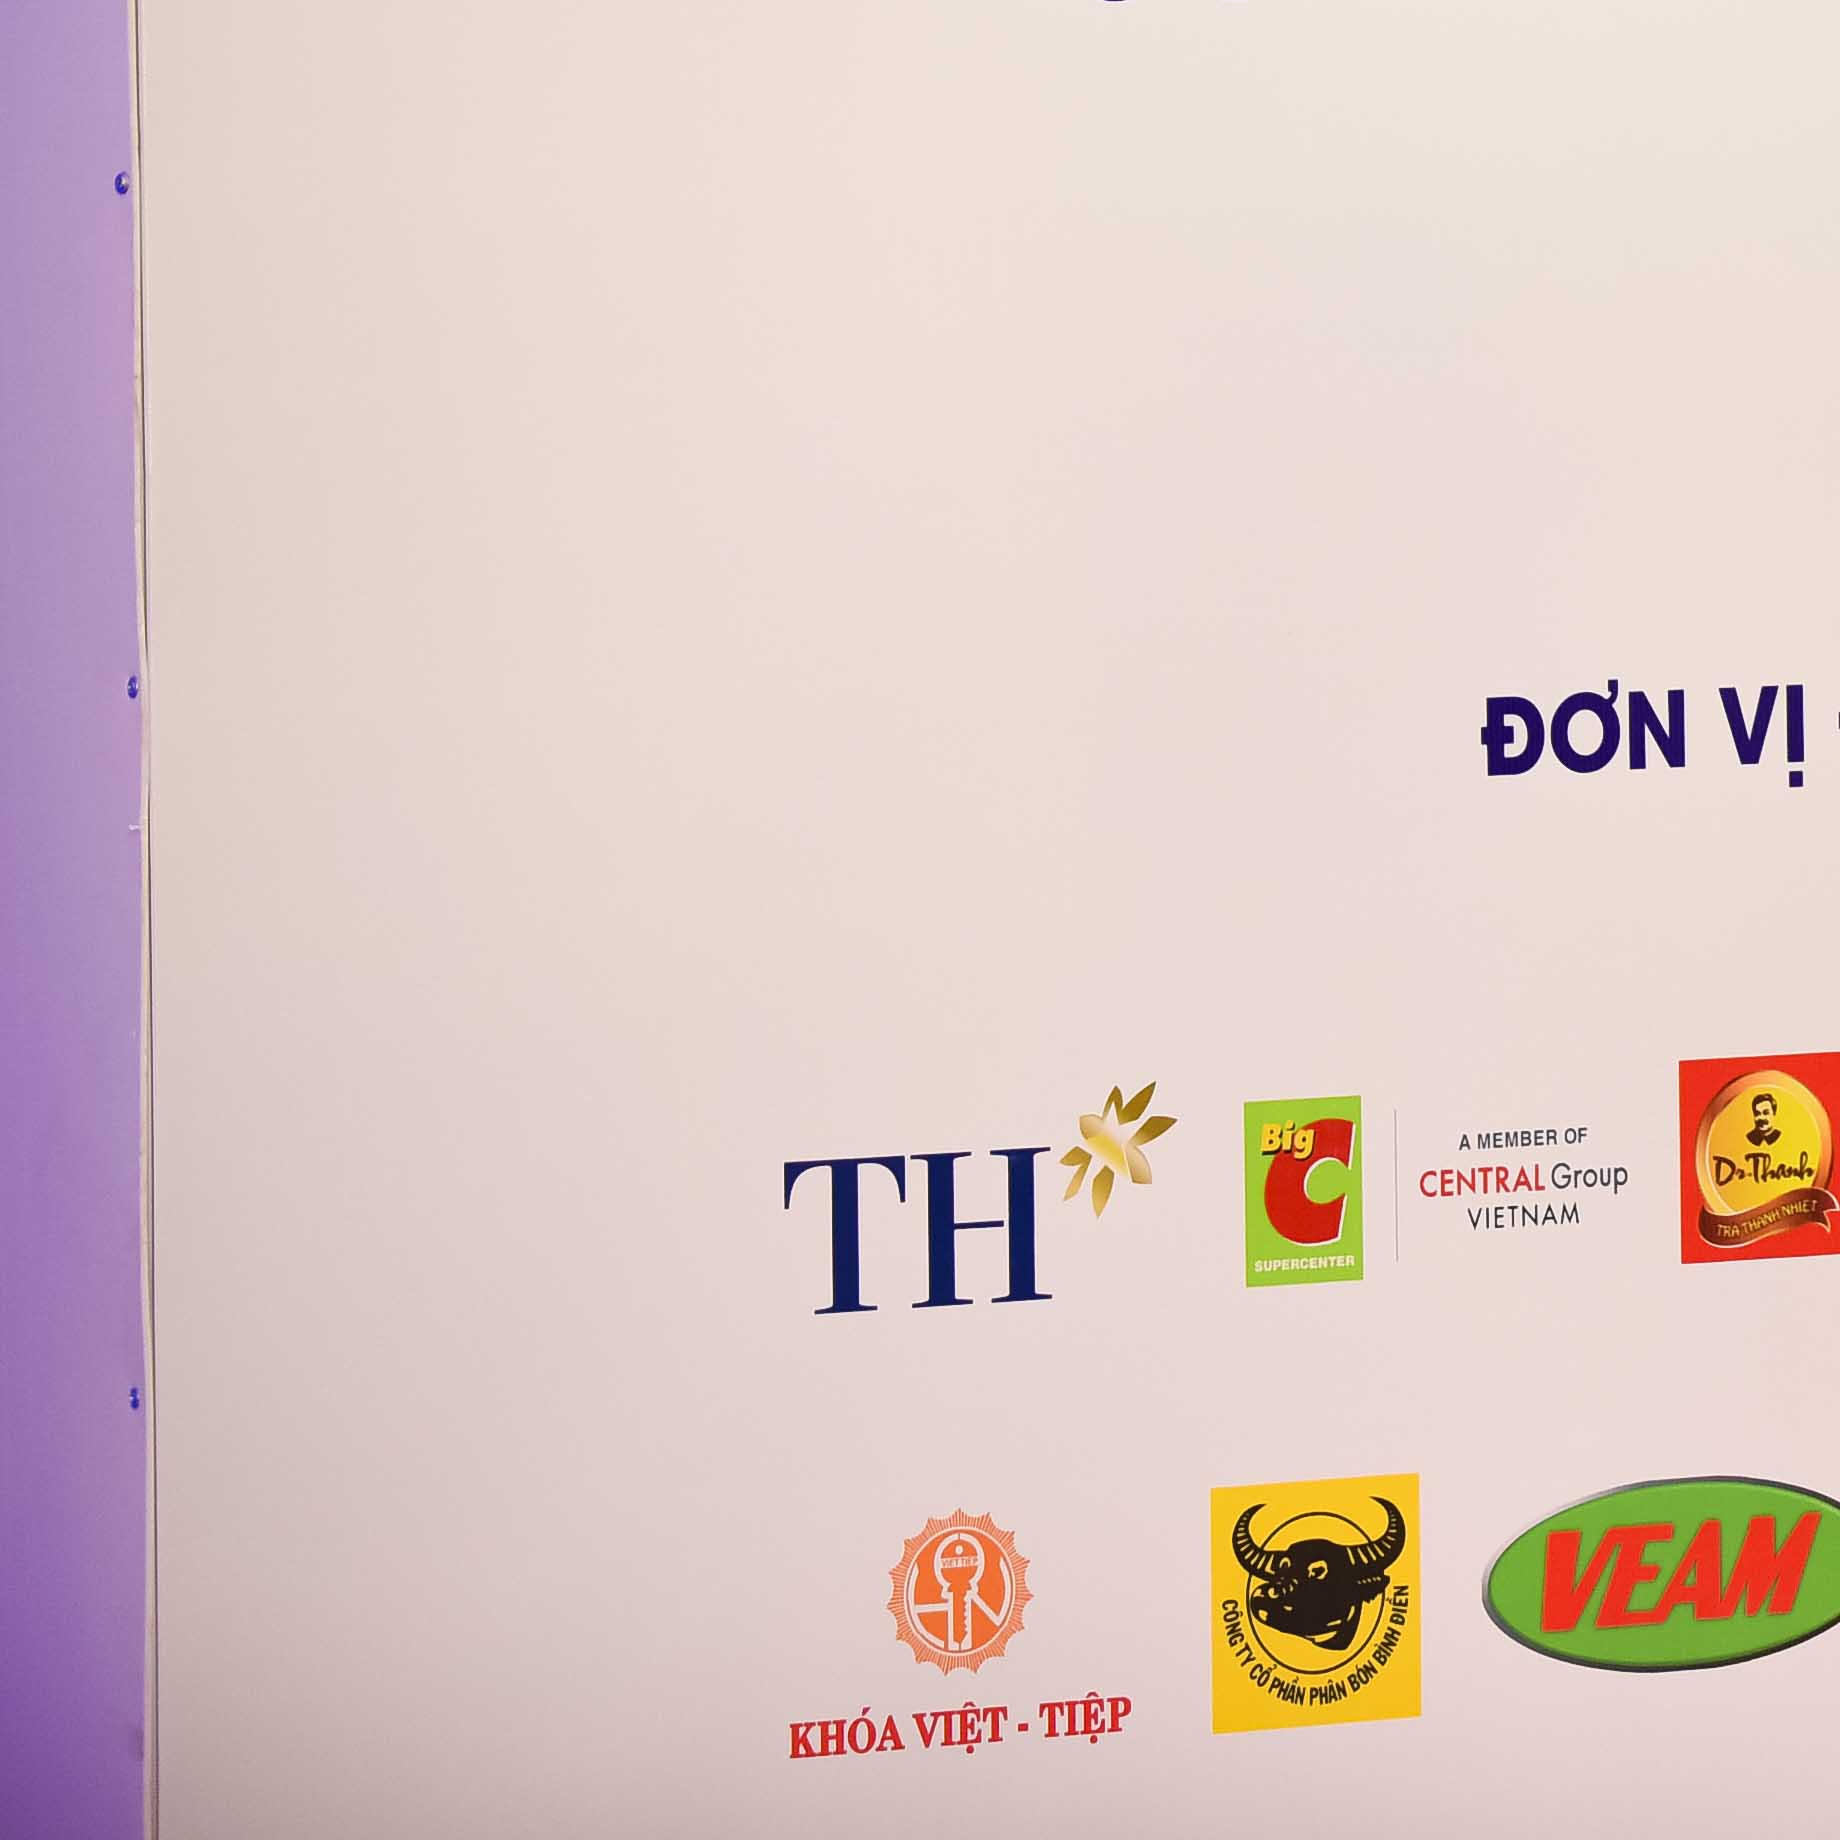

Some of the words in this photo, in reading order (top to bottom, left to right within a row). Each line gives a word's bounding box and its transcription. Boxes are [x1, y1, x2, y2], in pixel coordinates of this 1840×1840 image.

[1481, 680, 1685, 776] ĐƠN
[1719, 685, 1804, 787] VỊ
[1261, 1120, 1314, 1158] Big
[1459, 1134, 1470, 1150] A
[1478, 1129, 1557, 1149] MEMBER
[1565, 1127, 1587, 1144] OF
[1264, 1118, 1354, 1246] C
[1420, 1164, 1545, 1197] CENTRAL
[1552, 1163, 1628, 1194] Group
[784, 1147, 1052, 1314] TH
[1468, 1203, 1579, 1229] VIETNAM
[1255, 1255, 1354, 1272] SUPERCENTER
[1541, 1513, 1821, 1633] VEAM
[1222, 1599, 1244, 1647] CÔNG
[1235, 1644, 1256, 1668] TY
[1249, 1662, 1277, 1687] CỔ
[1347, 1661, 1378, 1692] BÓN
[790, 1707, 905, 1758] KHÓA
[912, 1702, 1008, 1754] VIỆT
[1039, 1692, 1131, 1744] TIỆP
